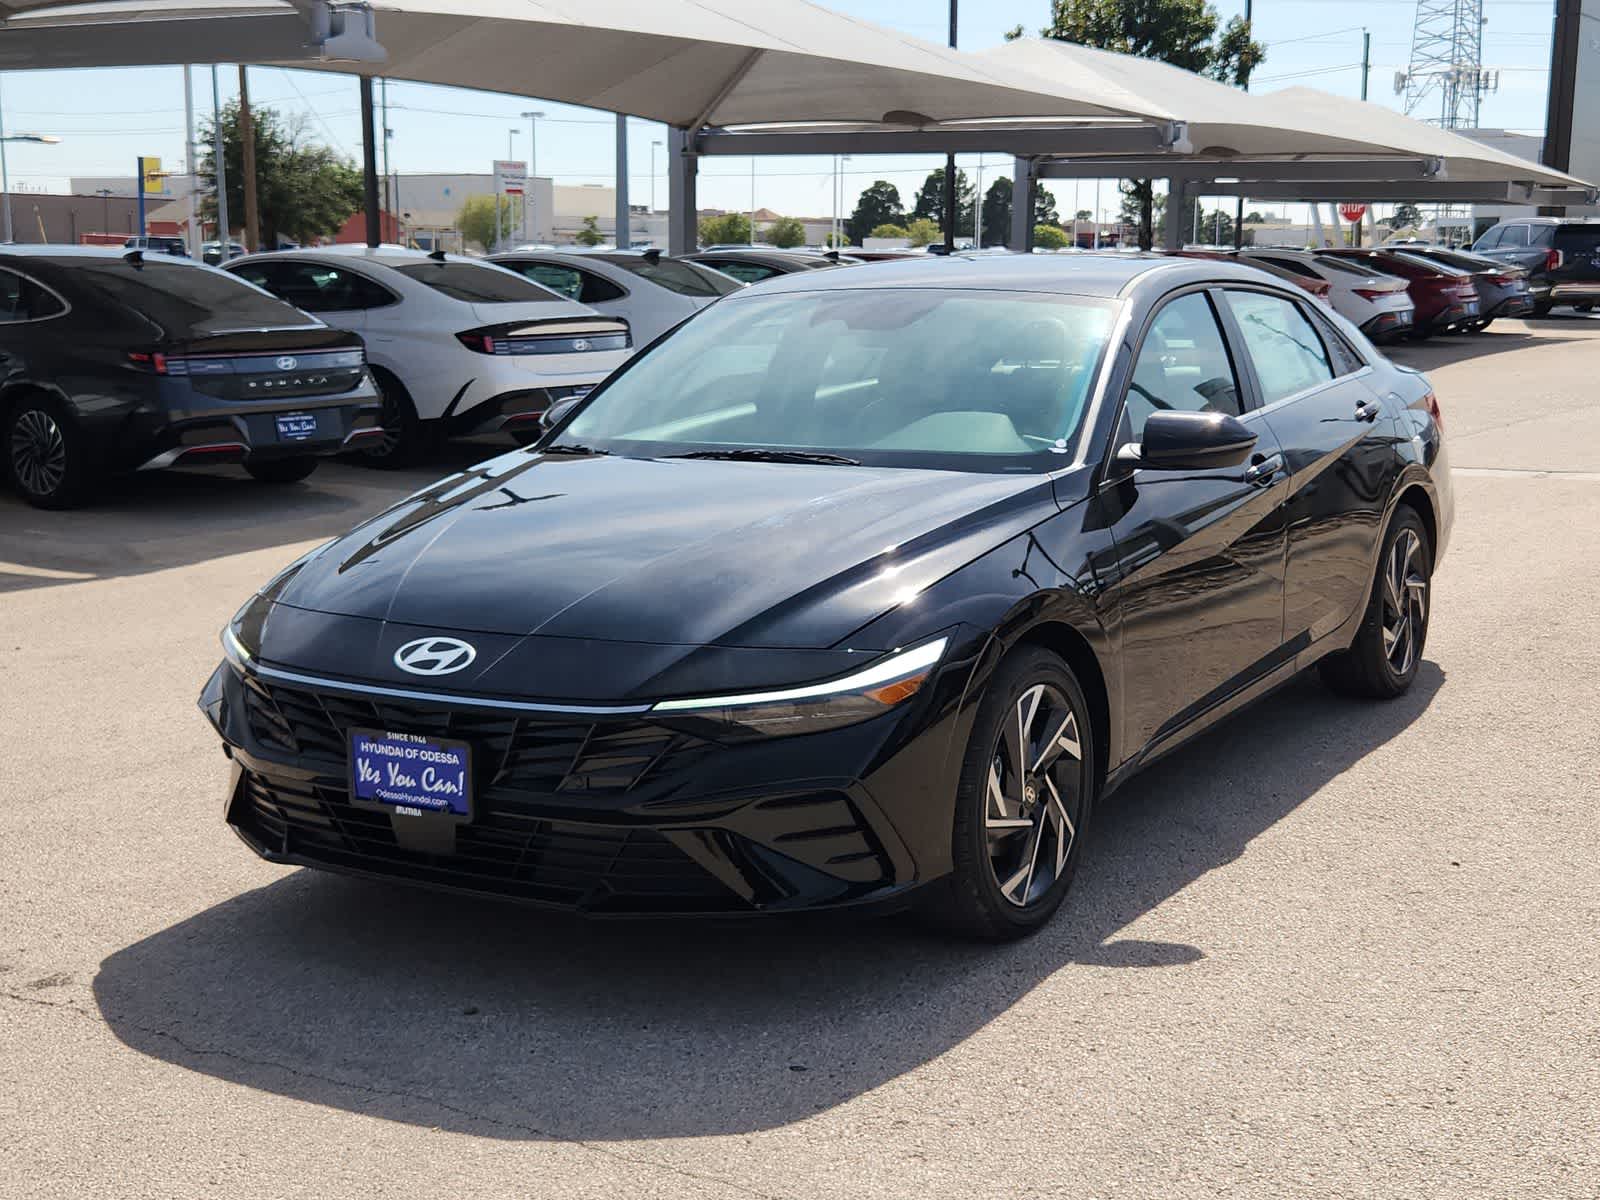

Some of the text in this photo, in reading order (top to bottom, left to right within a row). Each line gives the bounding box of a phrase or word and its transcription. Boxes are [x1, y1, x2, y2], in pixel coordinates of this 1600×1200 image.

[386, 731, 409, 742] SINCE
[360, 741, 459, 764] HYUNDAI OF ODESSA
[357, 757, 465, 797] Yes You Can!
[376, 789, 449, 806] OdessaHyundai.com
